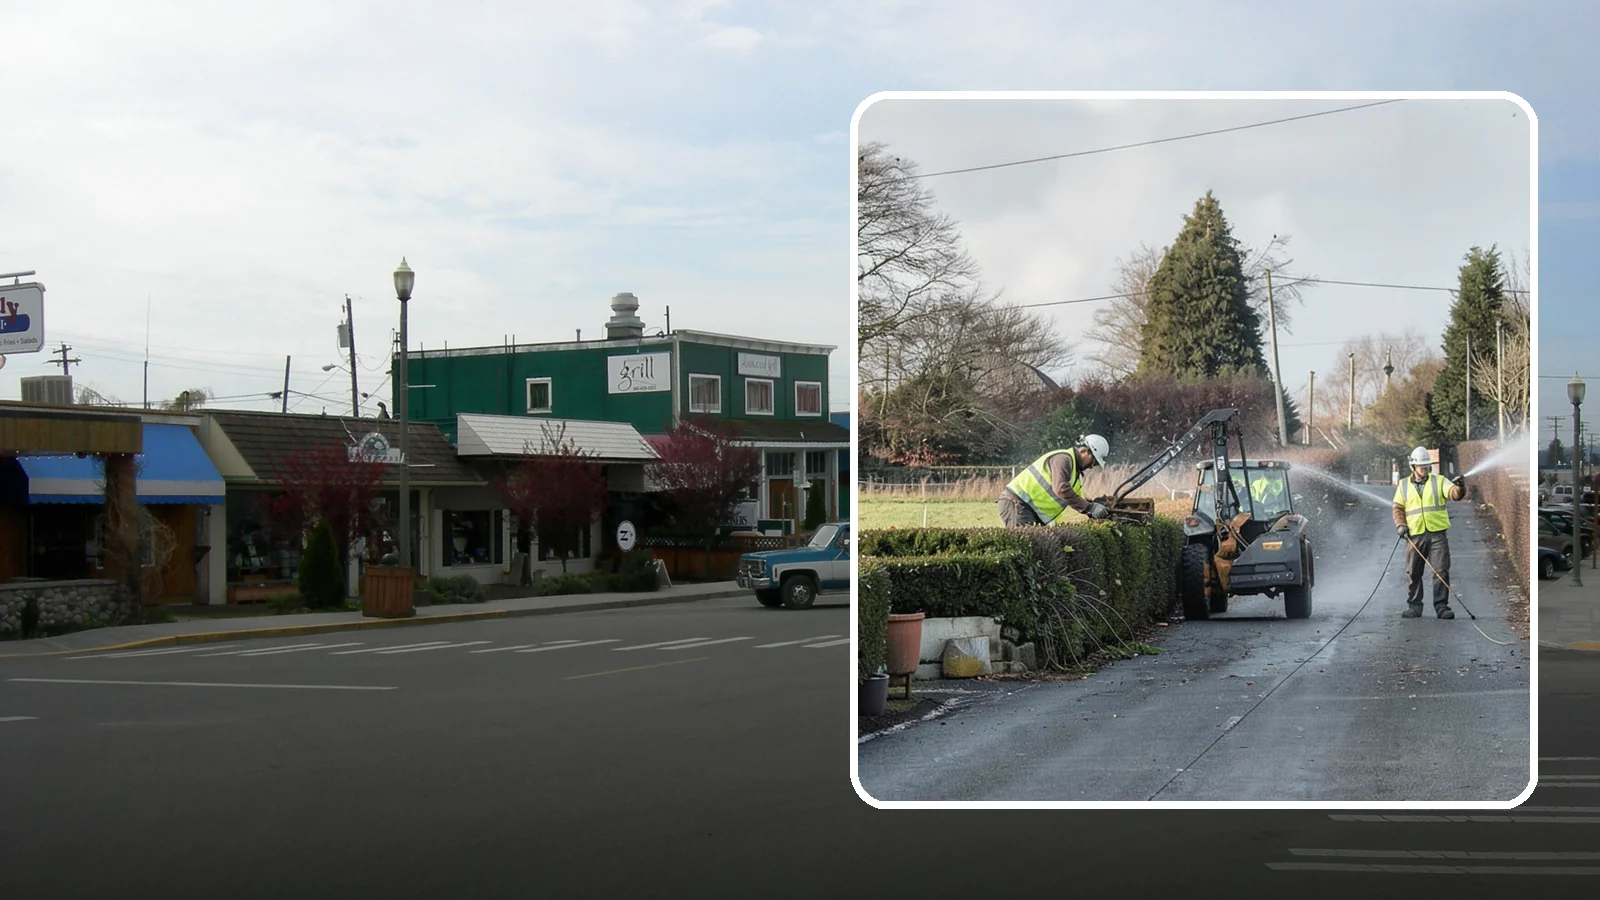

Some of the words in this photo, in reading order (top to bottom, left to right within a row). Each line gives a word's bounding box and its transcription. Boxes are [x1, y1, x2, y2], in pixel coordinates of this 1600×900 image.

[0, 297, 19, 325] ly
[20, 336, 38, 344] Salads
[618, 356, 654, 391] grill
